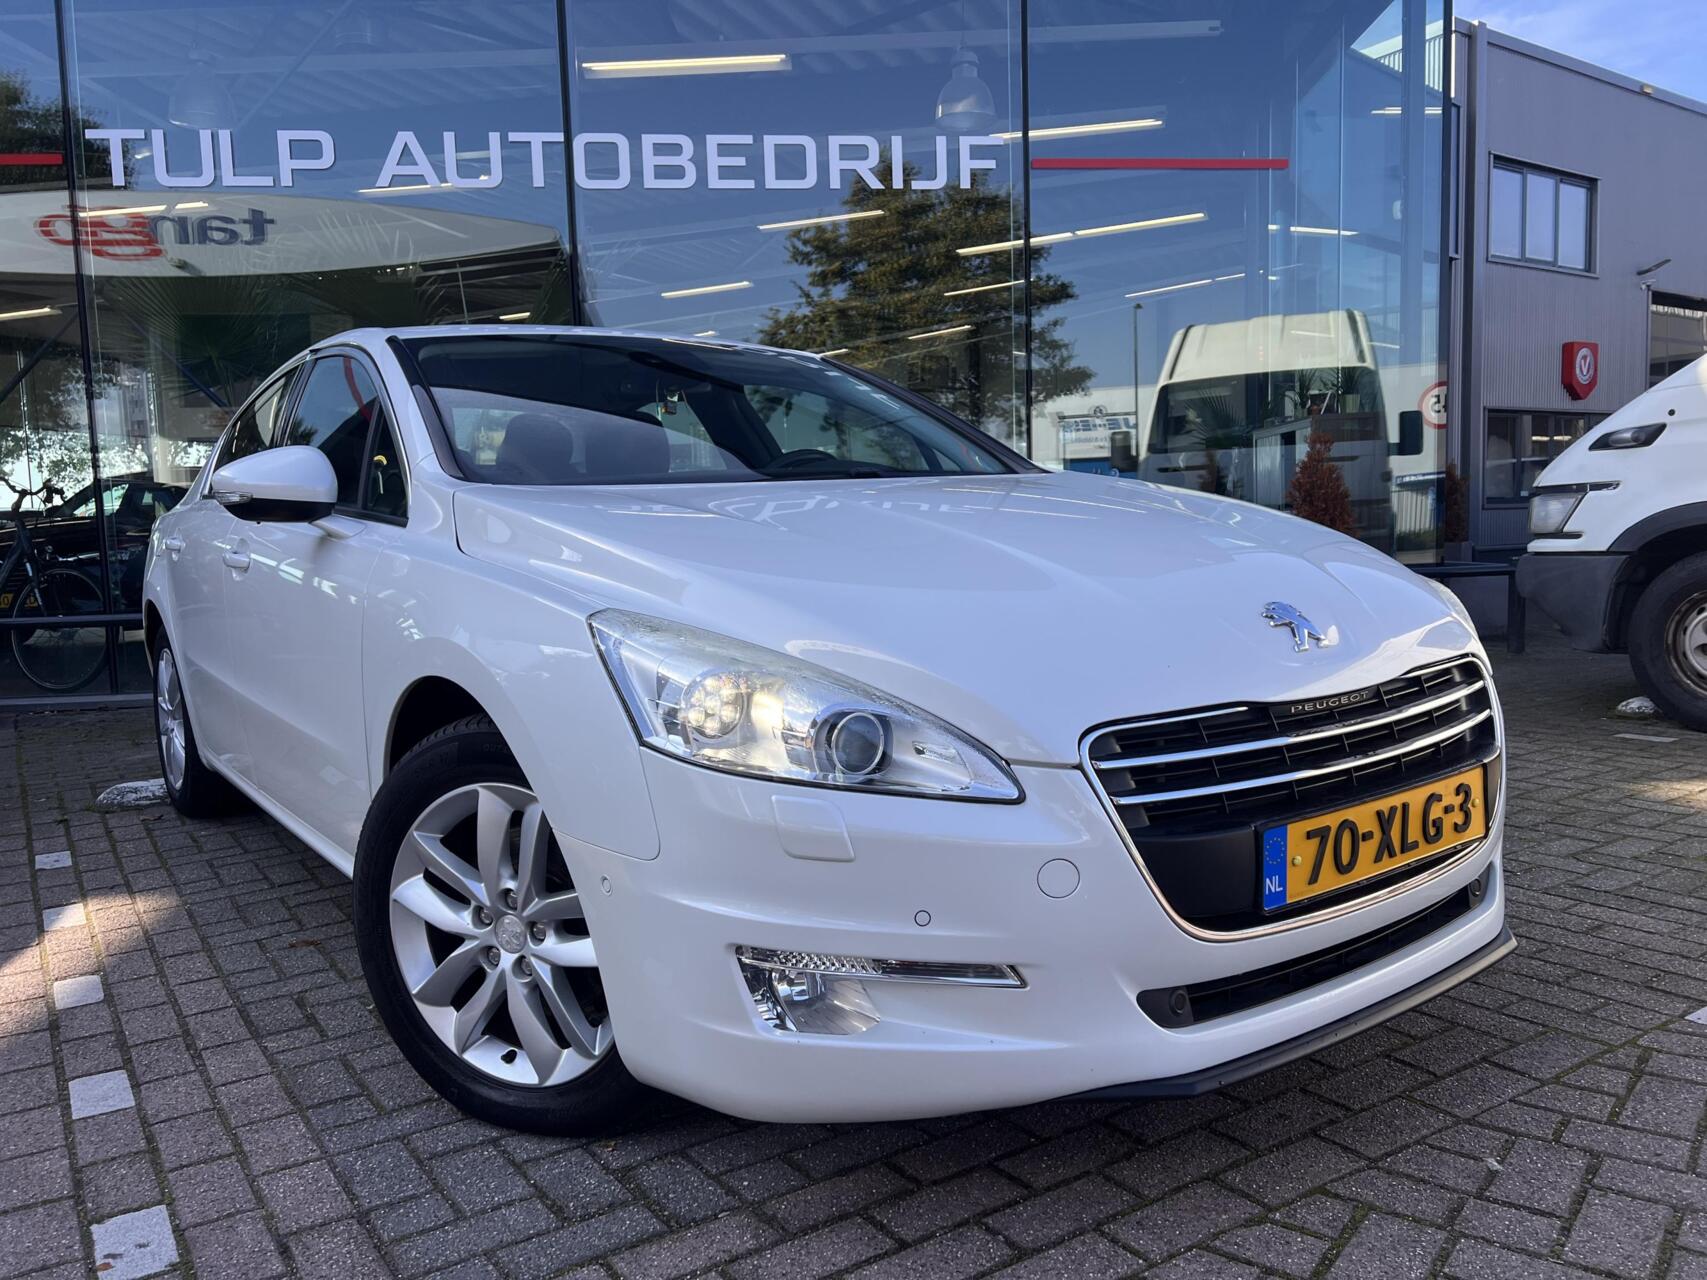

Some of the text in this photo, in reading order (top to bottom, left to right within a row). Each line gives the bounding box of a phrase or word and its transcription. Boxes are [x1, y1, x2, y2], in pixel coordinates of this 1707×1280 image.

[85, 129, 1005, 190] TULP AUTOBEDRIJF
[1291, 690, 1369, 713] PEUGEOT
[1306, 782, 1473, 885] 70-XLG-3
[1265, 875, 1284, 894] NL
